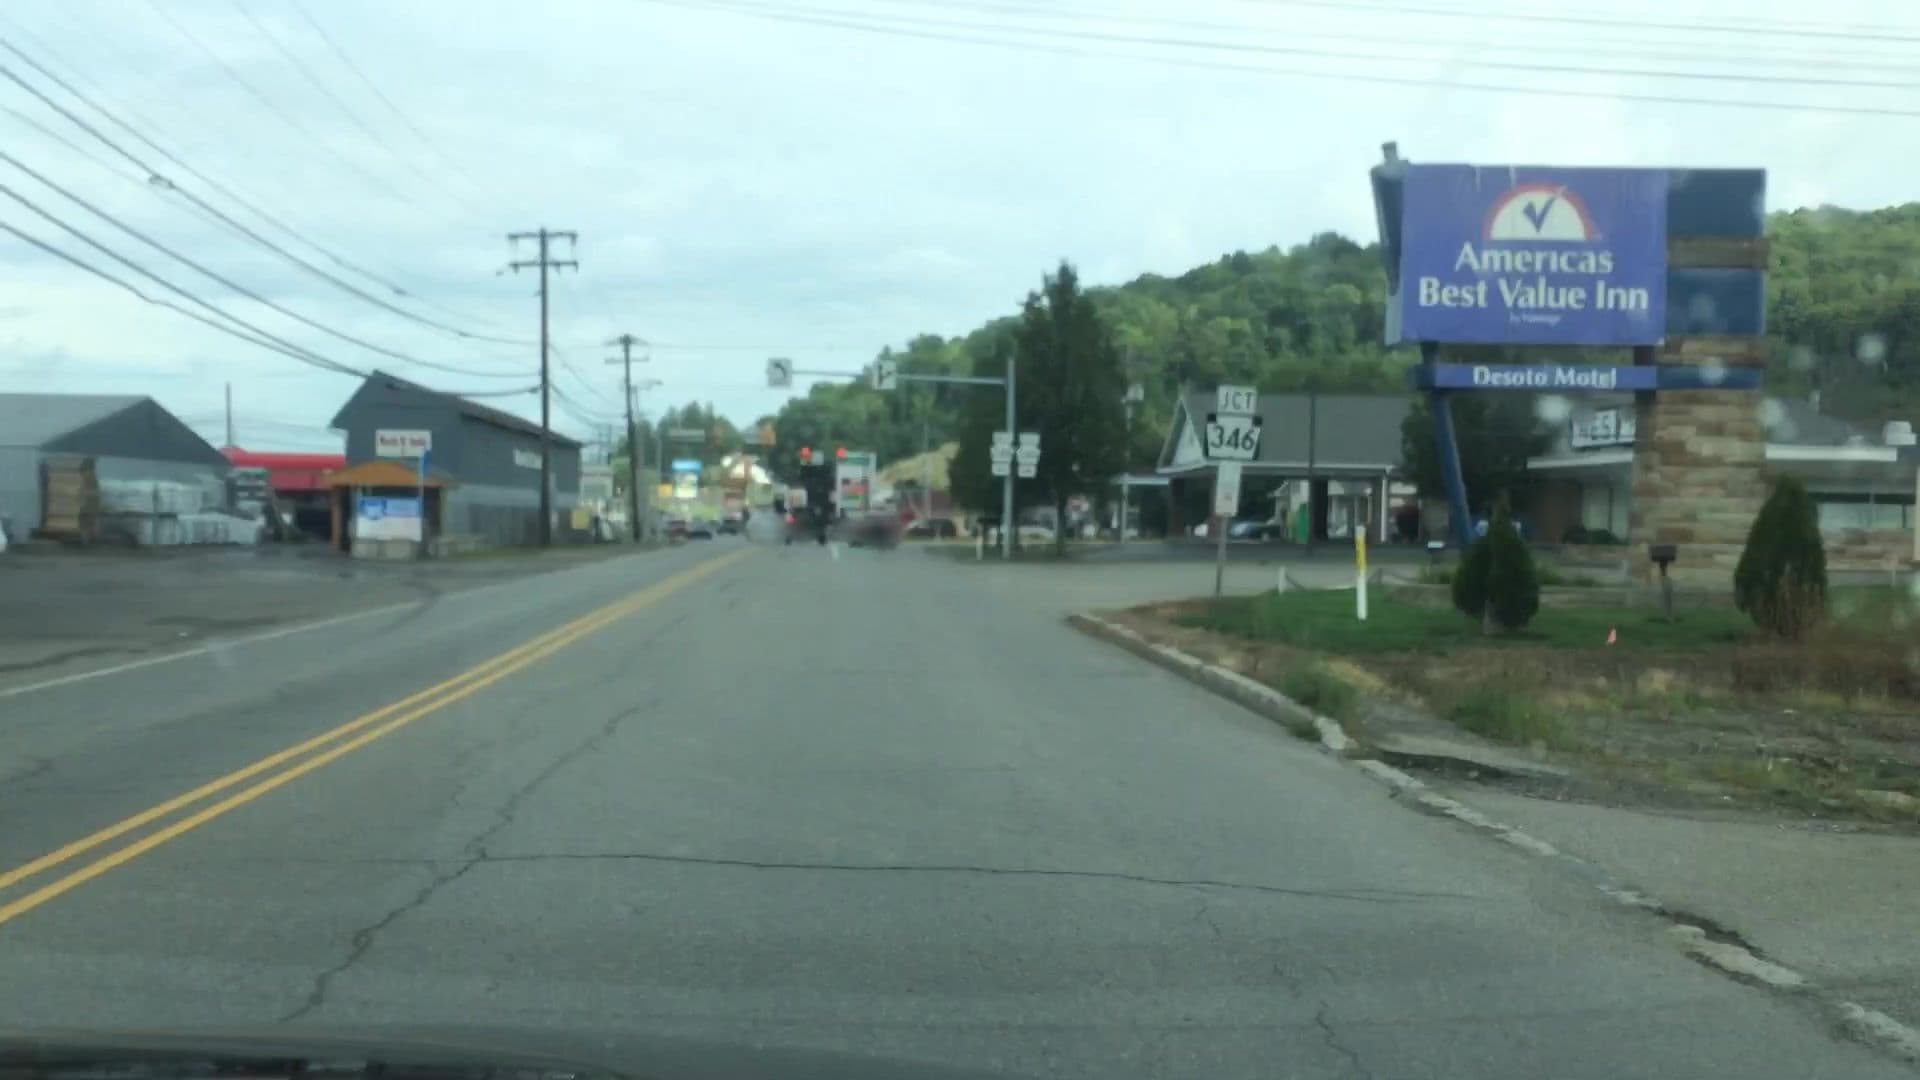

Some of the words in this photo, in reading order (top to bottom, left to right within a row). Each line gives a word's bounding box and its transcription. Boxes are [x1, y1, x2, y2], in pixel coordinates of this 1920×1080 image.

[1455, 241, 1614, 273] Americas
[1419, 277, 1488, 308] Best
[1498, 279, 1587, 310] Value
[1597, 280, 1649, 310] Inn
[1472, 366, 1548, 387] Desoto
[1555, 367, 1616, 388] Motel
[1222, 391, 1255, 411] JCT
[1210, 425, 1256, 451] 346
